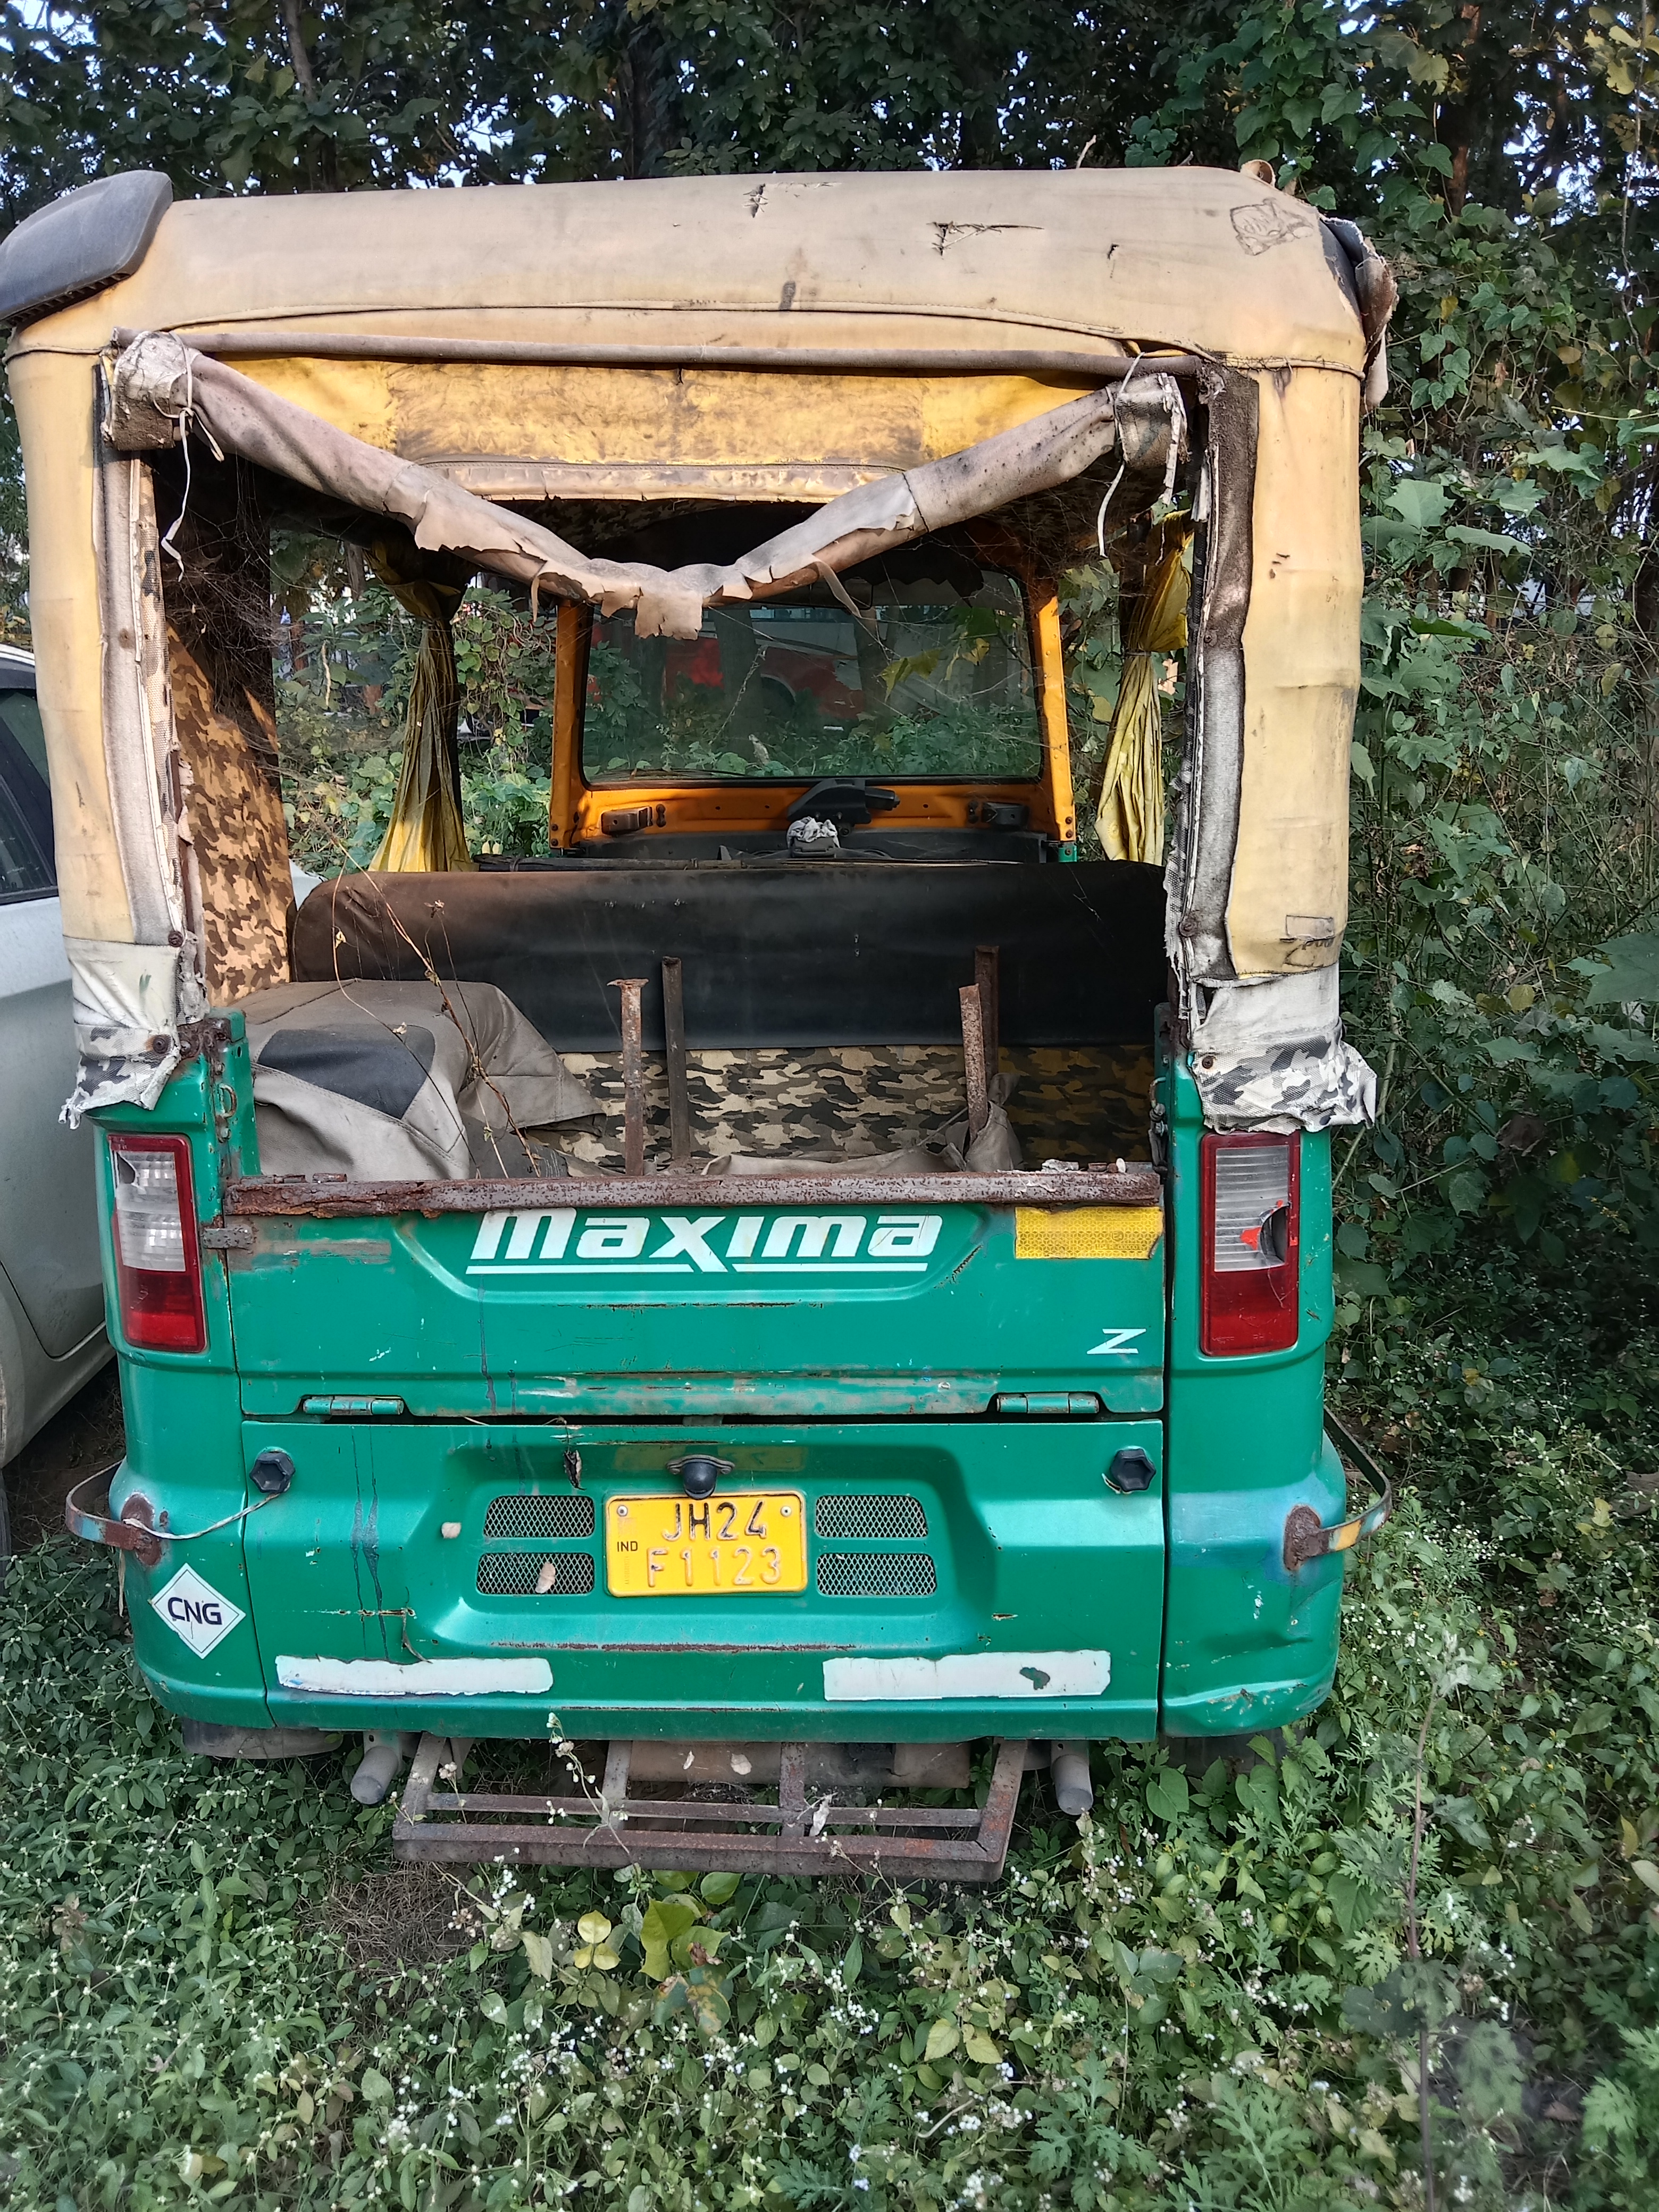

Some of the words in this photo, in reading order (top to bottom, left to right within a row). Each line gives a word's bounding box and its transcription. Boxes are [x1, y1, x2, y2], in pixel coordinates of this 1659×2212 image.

[1087, 1328, 1146, 1354] Z
[662, 1501, 767, 1541] JH24
[617, 1541, 638, 1552] IND
[647, 1547, 783, 1587] F1123
[167, 1597, 222, 1625] CNG
